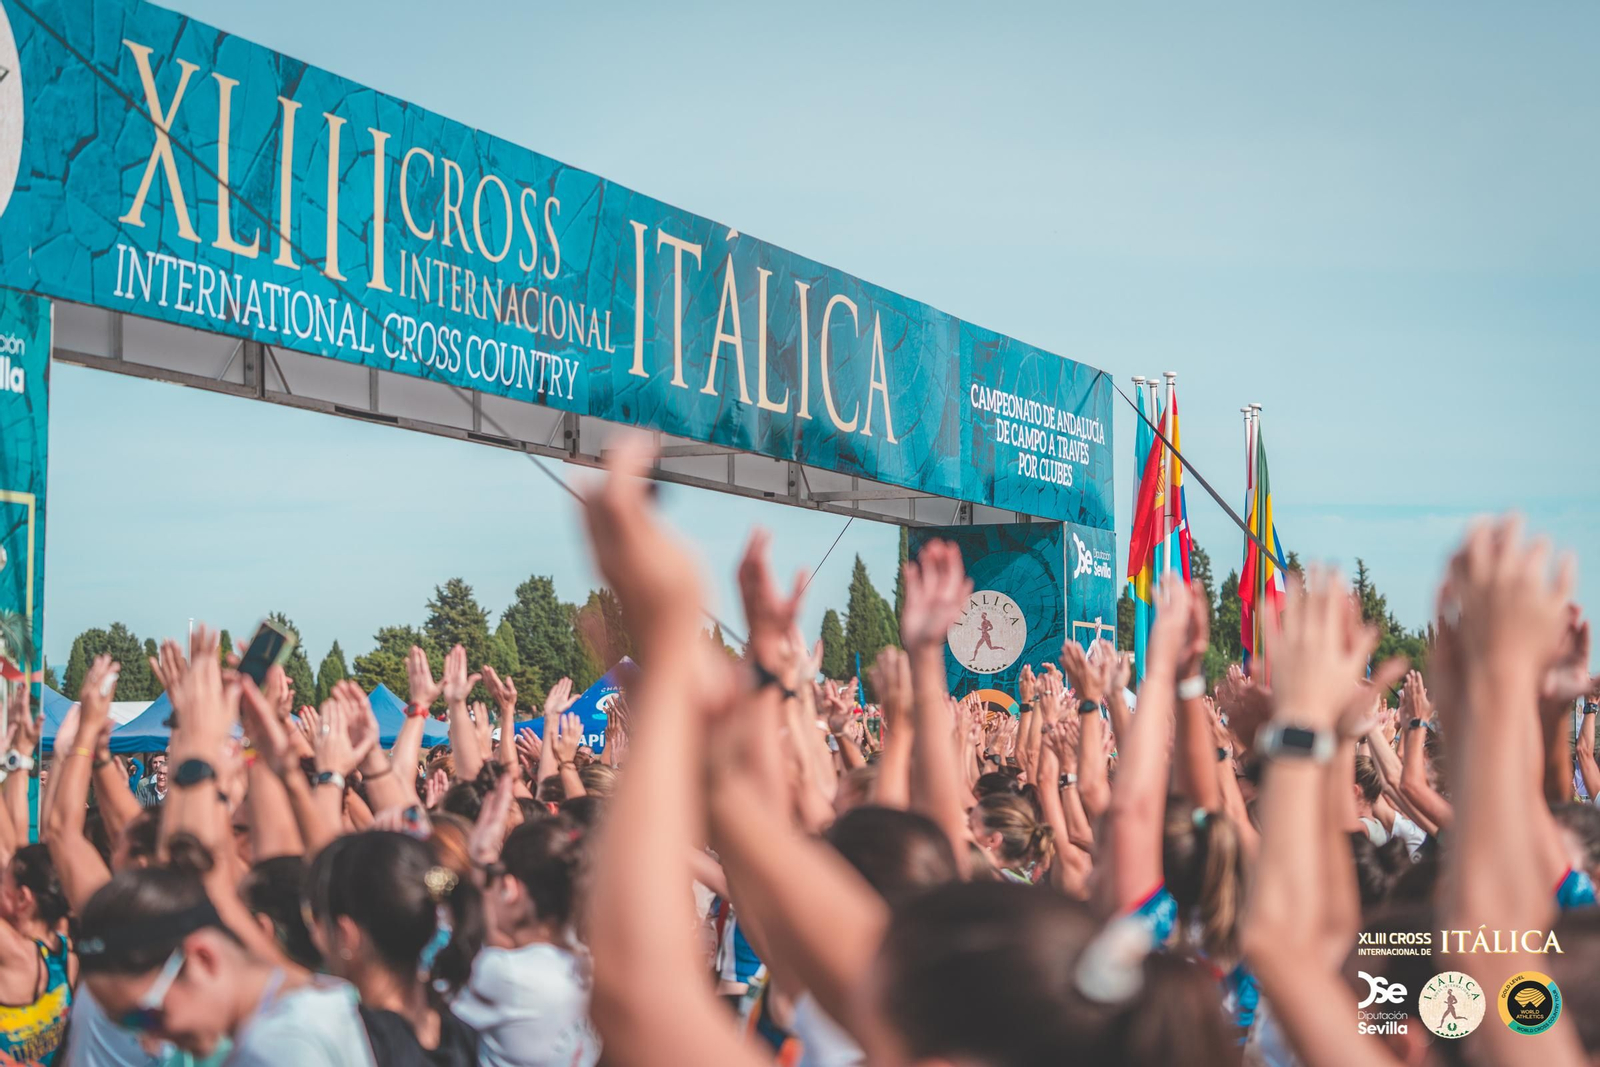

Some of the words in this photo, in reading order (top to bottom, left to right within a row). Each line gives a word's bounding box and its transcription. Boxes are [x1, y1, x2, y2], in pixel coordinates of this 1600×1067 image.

[118, 39, 393, 293] XLIII
[400, 147, 560, 280] CROSS
[114, 244, 375, 354] INTERNATIONAL
[382, 312, 461, 373] CROSS
[465, 335, 579, 400] COUNTRY
[399, 250, 615, 354] INTERNACIONAL
[629, 219, 898, 445] ITÁLICA
[970, 383, 1042, 425] CAMPEONATO
[1043, 404, 1056, 430] DE
[1057, 409, 1105, 445] ANDALUCÍA
[996, 418, 1010, 444] DE
[1011, 422, 1047, 453] CAMPO
[1048, 433, 1056, 456] A
[1057, 434, 1089, 465] TRAVÉS
[1018, 452, 1038, 479] POR
[1039, 457, 1073, 487] CLUBES
[1093, 560, 1112, 579] Sevilla
